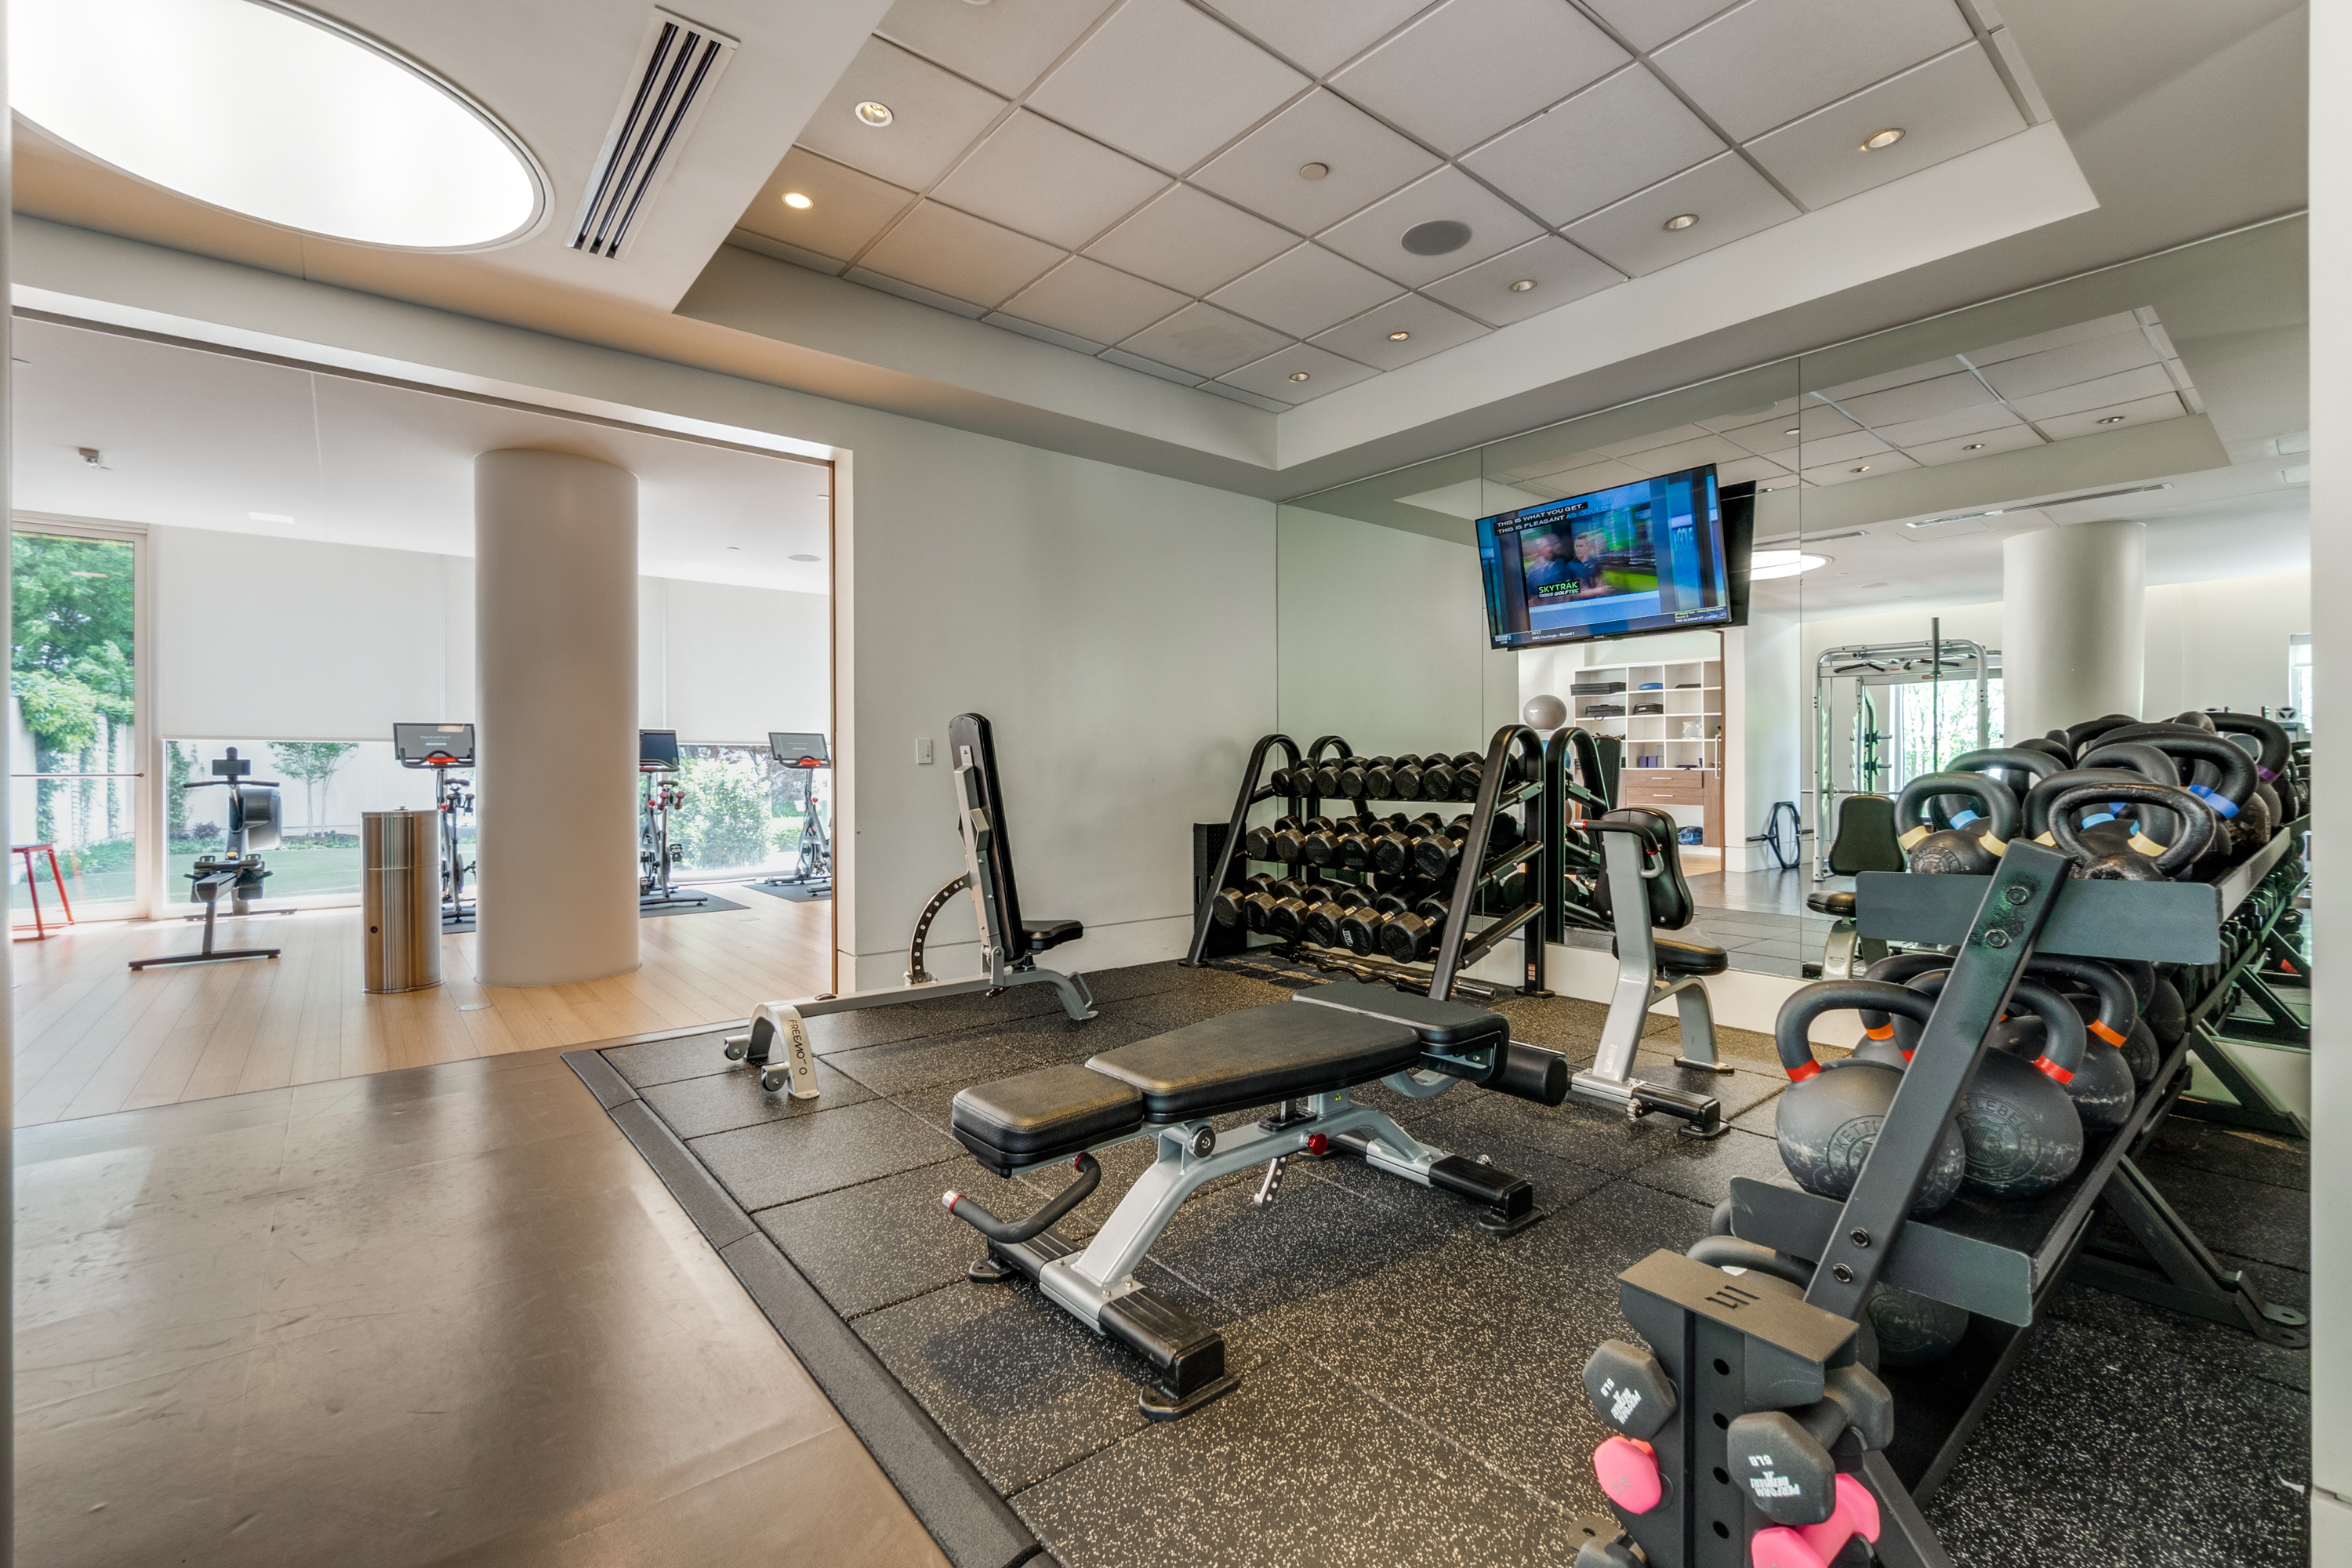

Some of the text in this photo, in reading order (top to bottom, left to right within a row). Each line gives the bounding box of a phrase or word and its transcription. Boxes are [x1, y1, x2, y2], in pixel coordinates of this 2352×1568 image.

[1523, 513, 1544, 521] WHAT
[1564, 503, 1584, 512] GET.
[1524, 516, 1564, 528] PLEASANT
[1538, 581, 1578, 593] SKYTRAK
[1600, 1377, 1615, 1397] 5LB
[1748, 1454, 1773, 1467] 5LB
[1755, 1483, 1801, 1497] PERFORM
